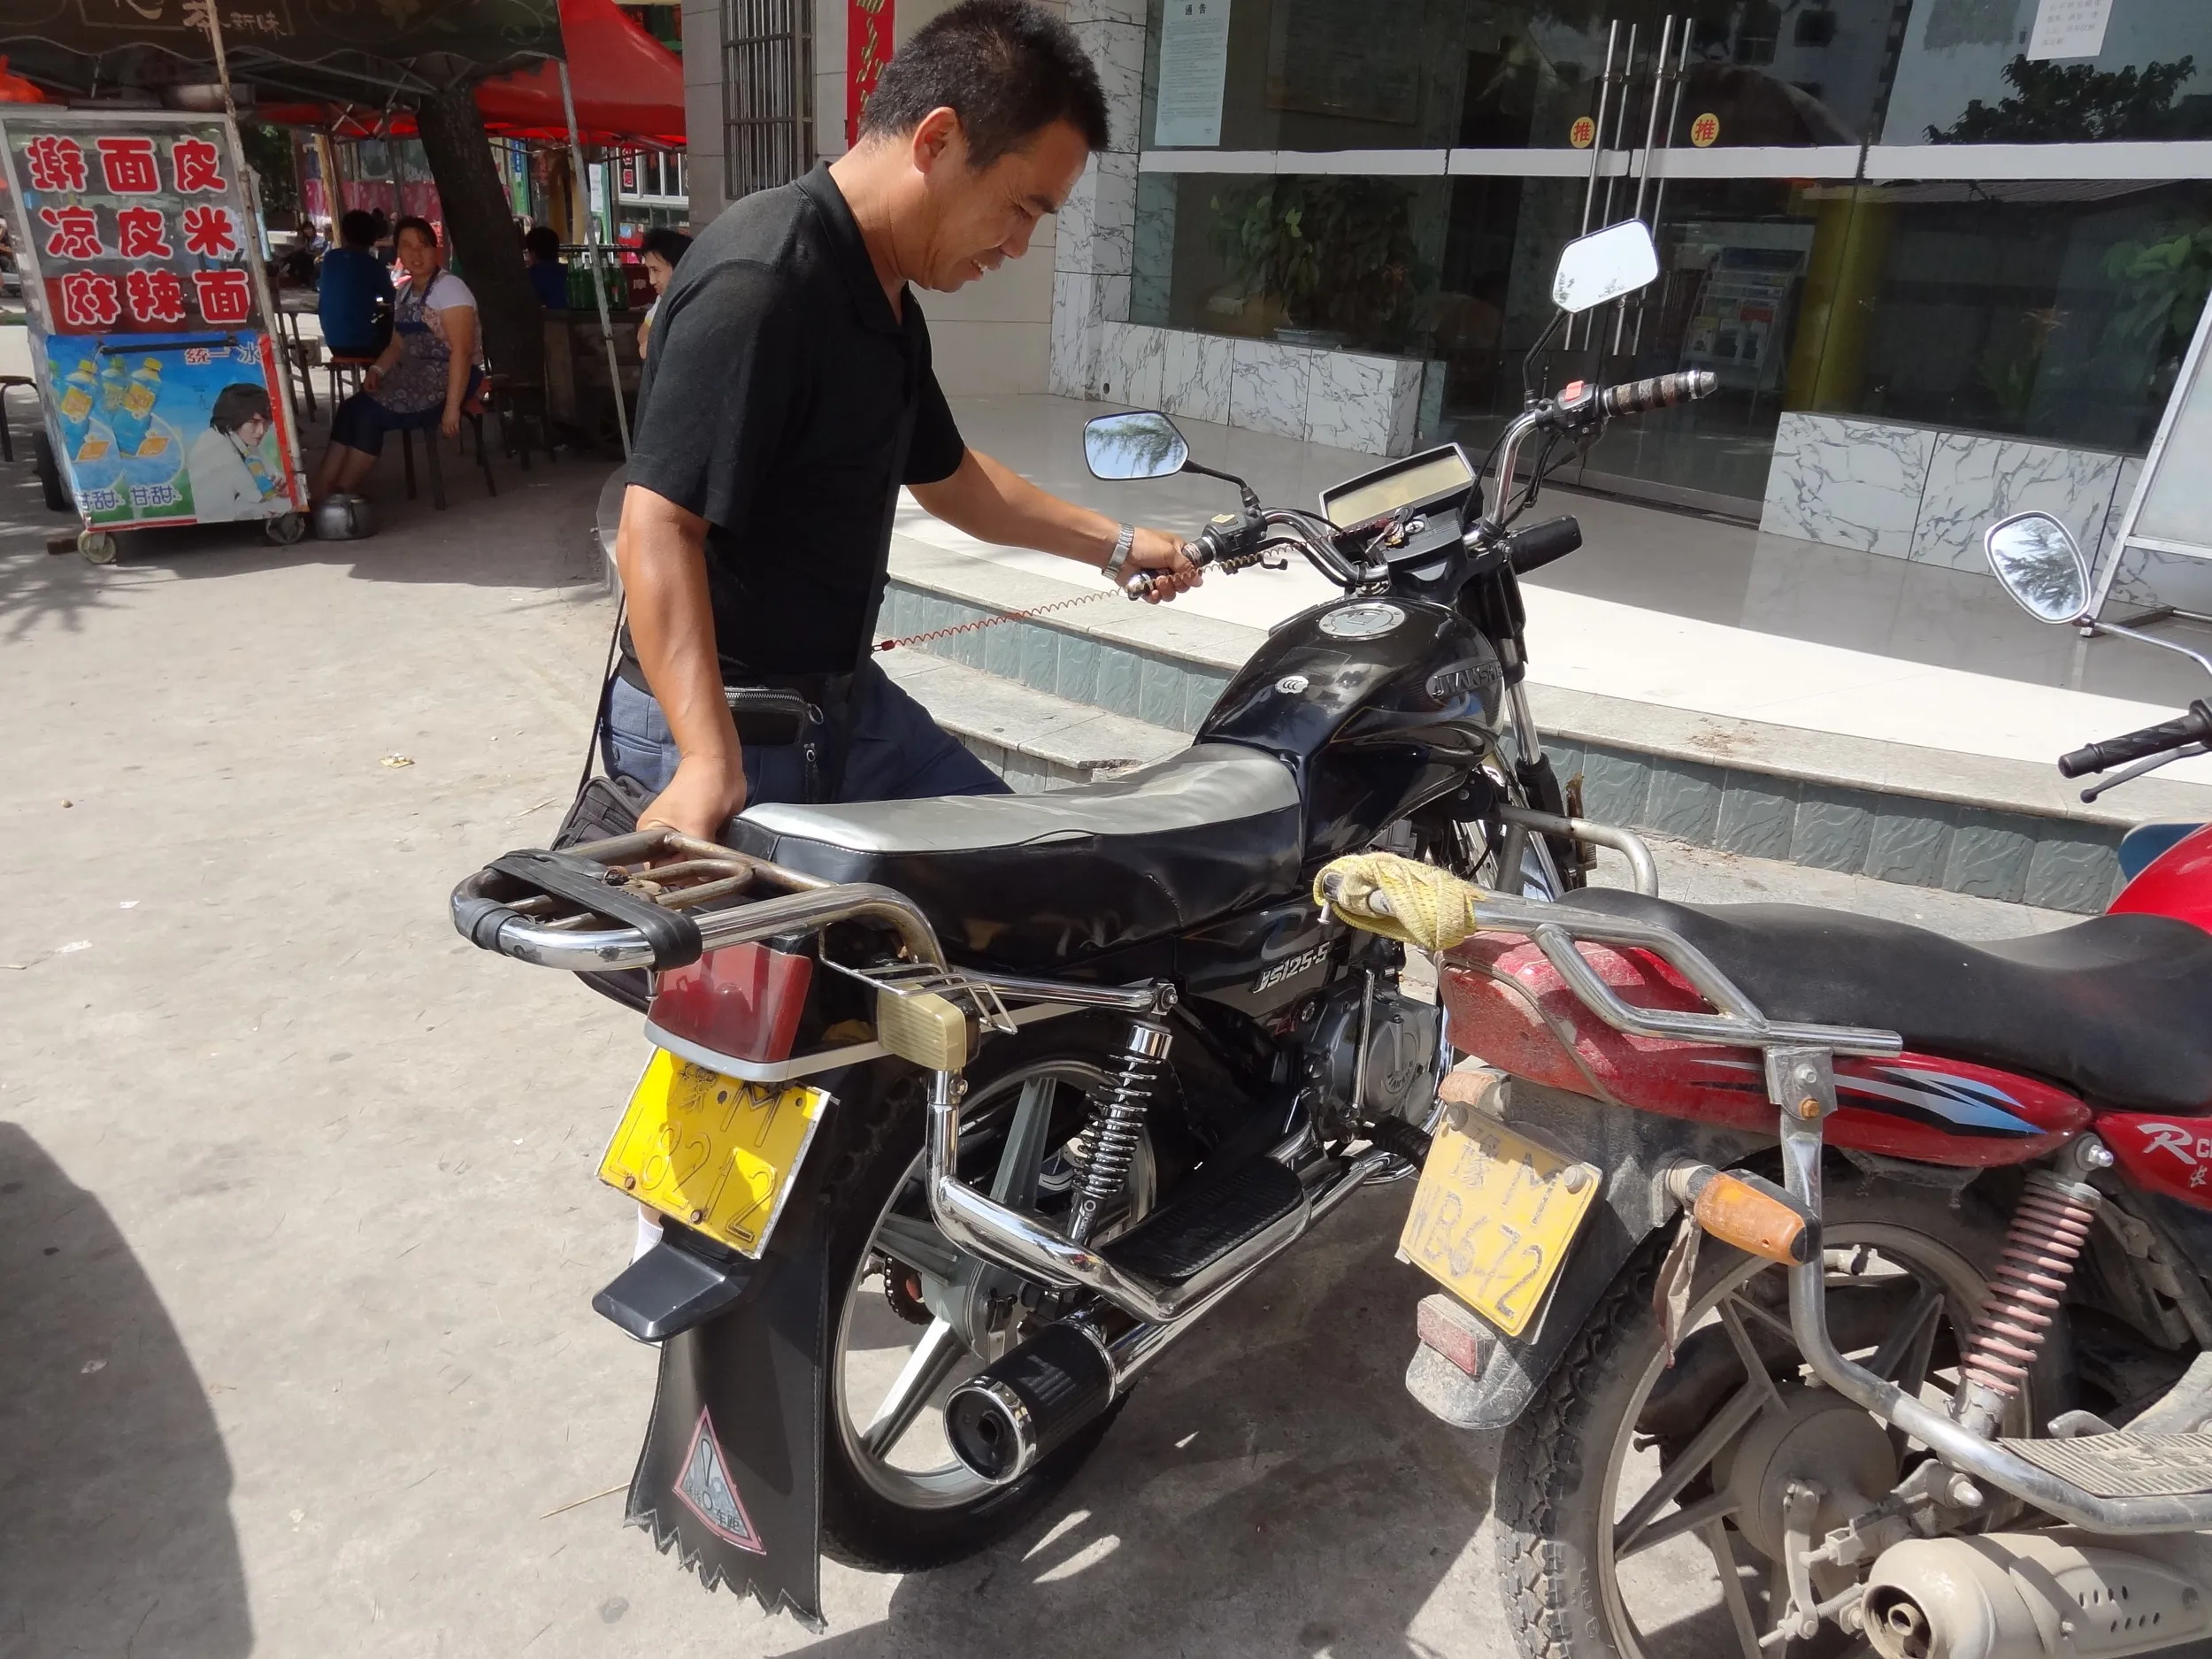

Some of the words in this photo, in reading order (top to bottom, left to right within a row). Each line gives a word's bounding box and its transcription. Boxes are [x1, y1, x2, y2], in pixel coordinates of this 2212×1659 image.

[1185, 4, 1207, 15] 通告
[1574, 122, 1591, 142] 推
[1695, 119, 1717, 141] 推
[39, 204, 238, 260] 凉皮米
[62, 268, 251, 326] 麻辣面
